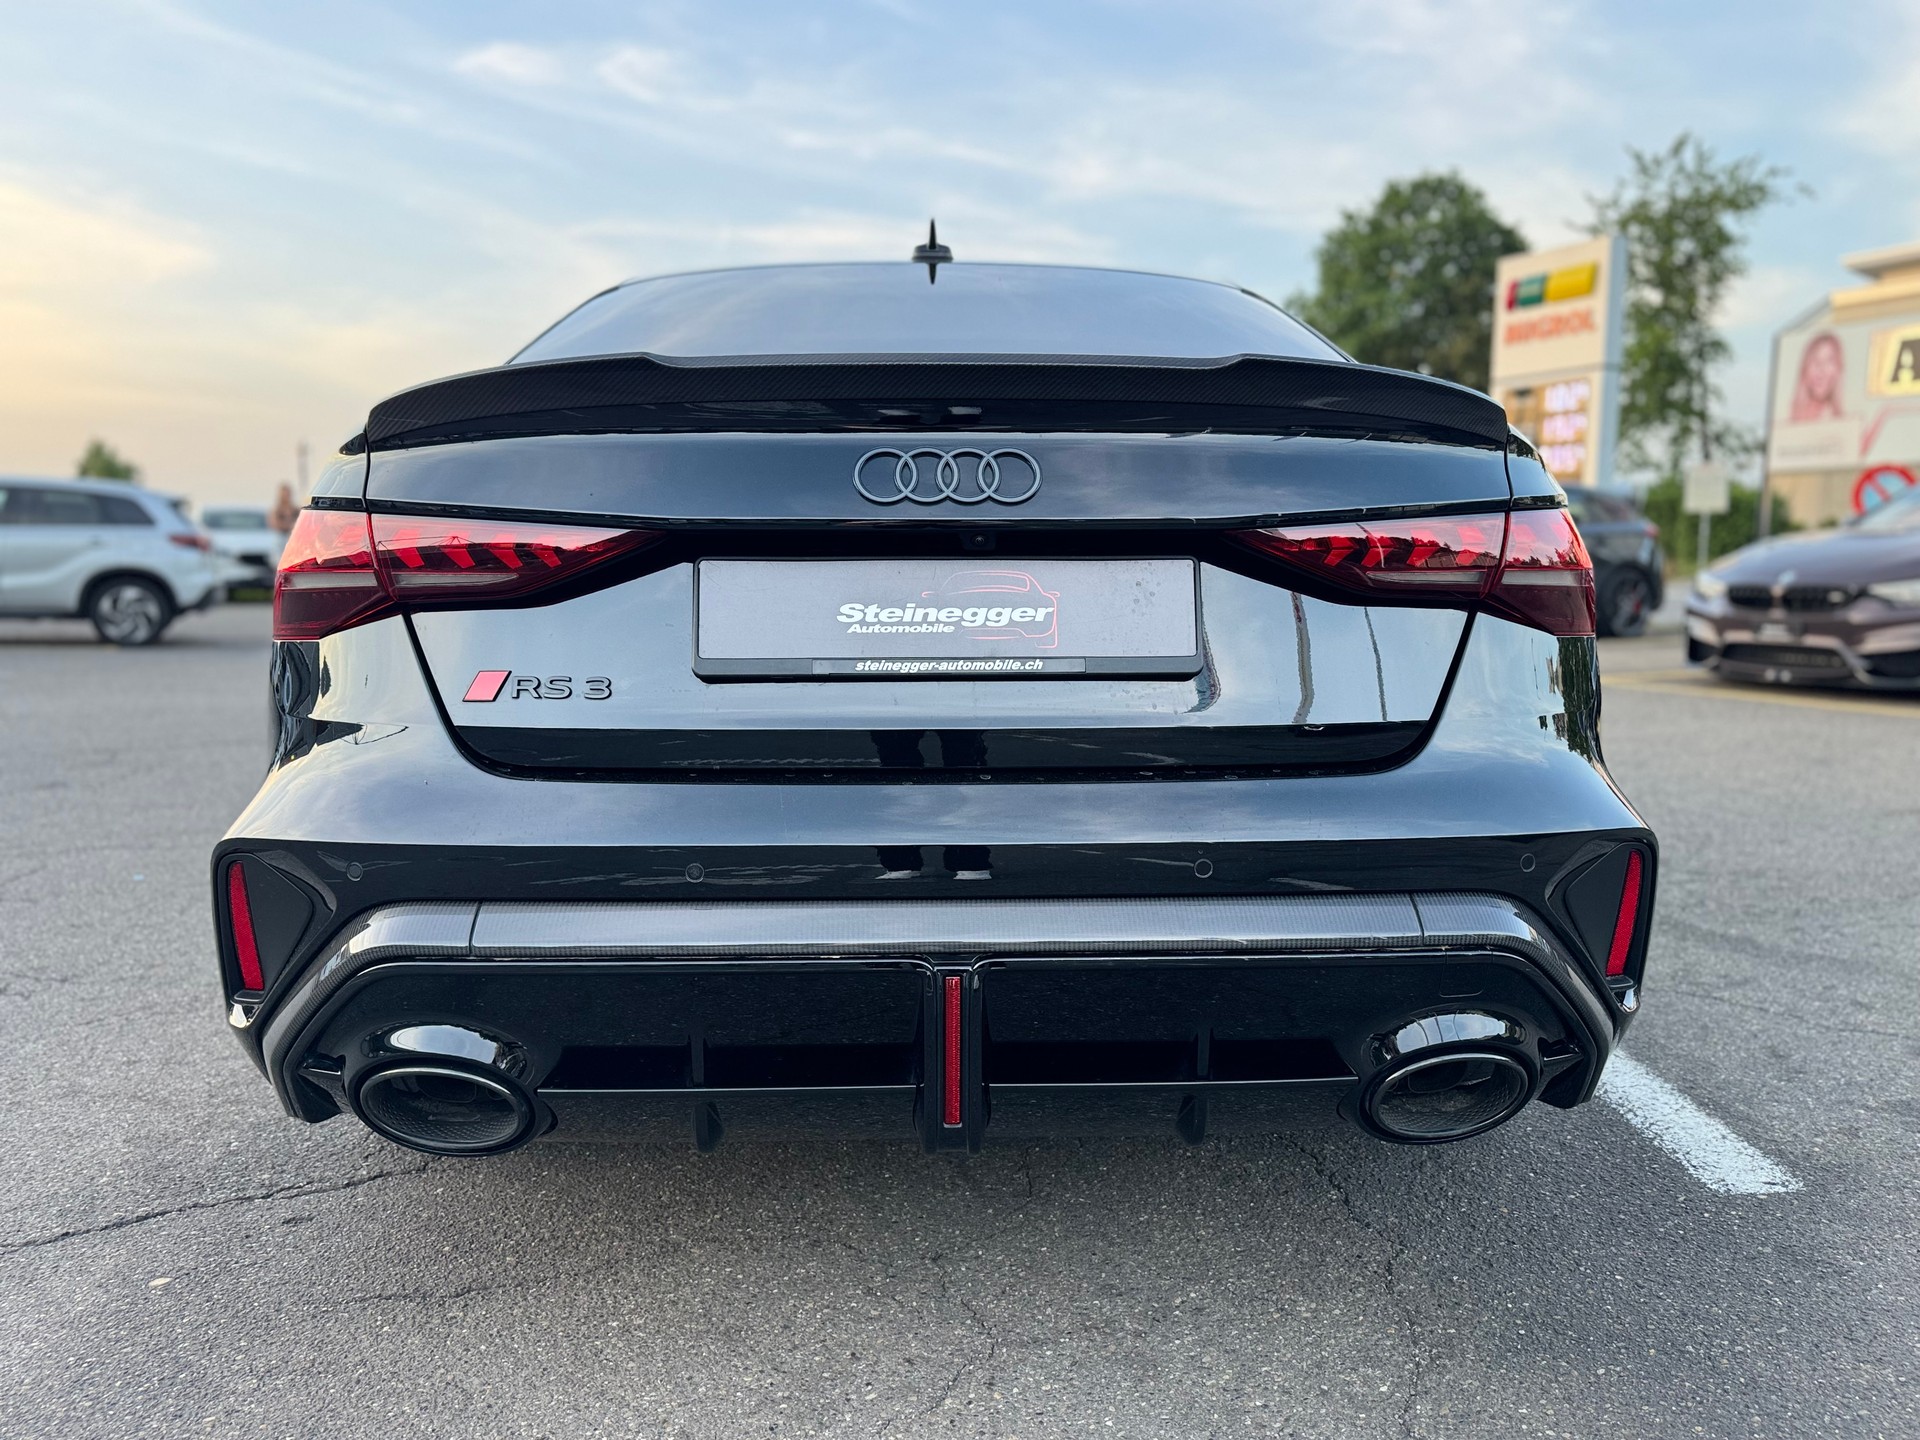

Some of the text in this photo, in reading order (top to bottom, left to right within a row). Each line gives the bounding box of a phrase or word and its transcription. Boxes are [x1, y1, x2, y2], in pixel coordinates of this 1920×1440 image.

[836, 603, 1055, 627] Steinegger
[847, 623, 955, 633] Automobile
[855, 659, 1043, 673] steinegger-automobile.ch
[511, 675, 612, 700] RS 3
